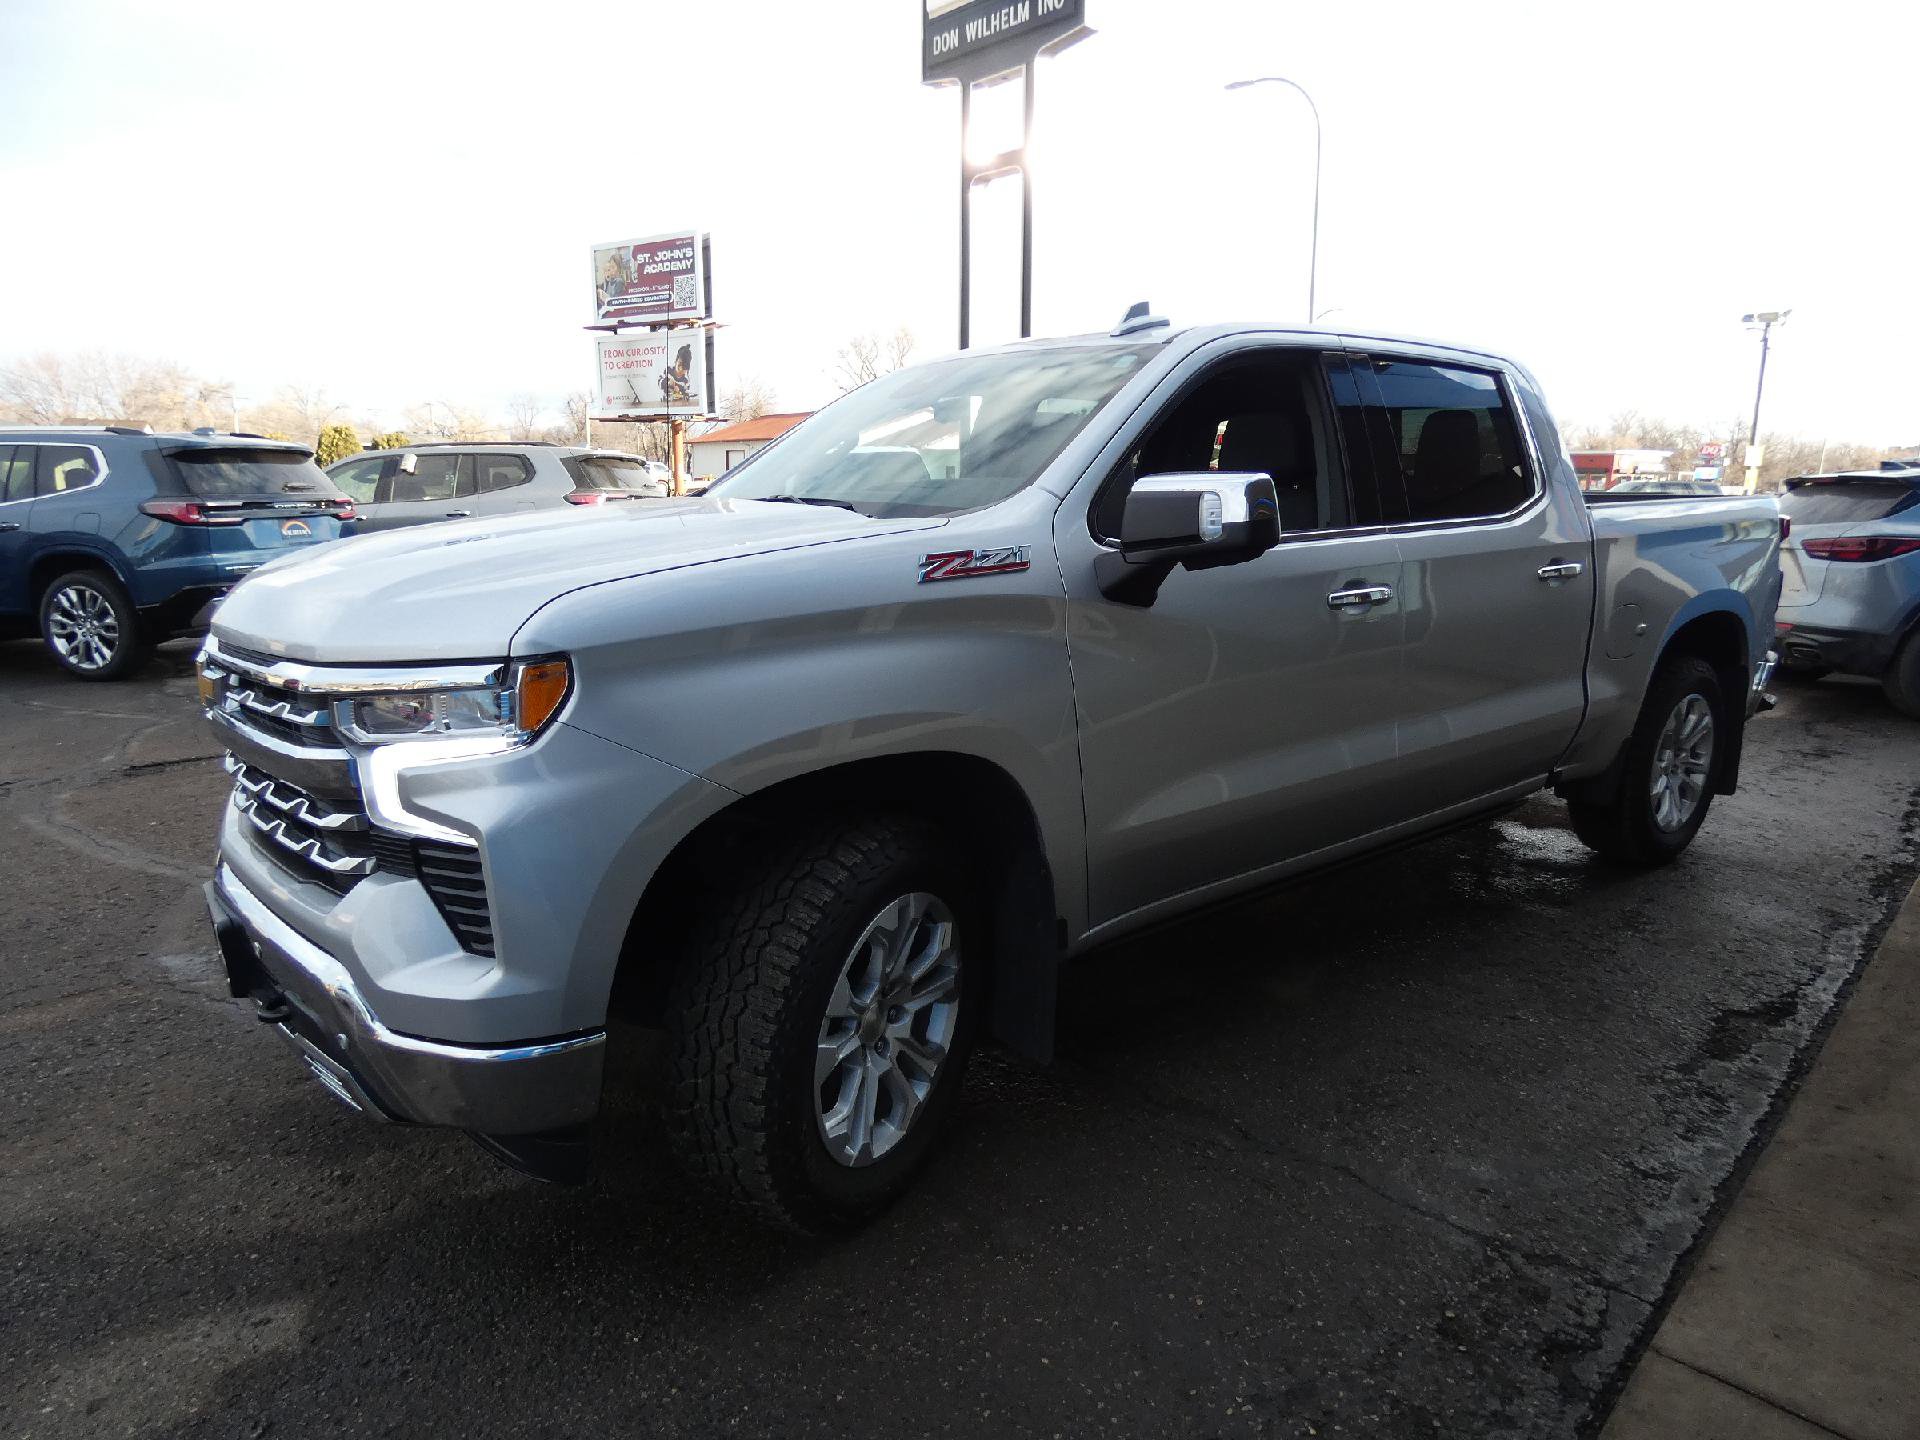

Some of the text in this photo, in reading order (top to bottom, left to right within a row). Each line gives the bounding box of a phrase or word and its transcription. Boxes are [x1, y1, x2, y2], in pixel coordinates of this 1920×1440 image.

[933, 0, 1065, 56] DON WILHELM INC
[637, 247, 693, 263] ST. JOHN'S
[643, 258, 693, 275] ACADEMY
[603, 346, 666, 359] FROM CURIOSITY
[604, 359, 653, 370] TO CREATION
[917, 544, 1032, 585] Z71
